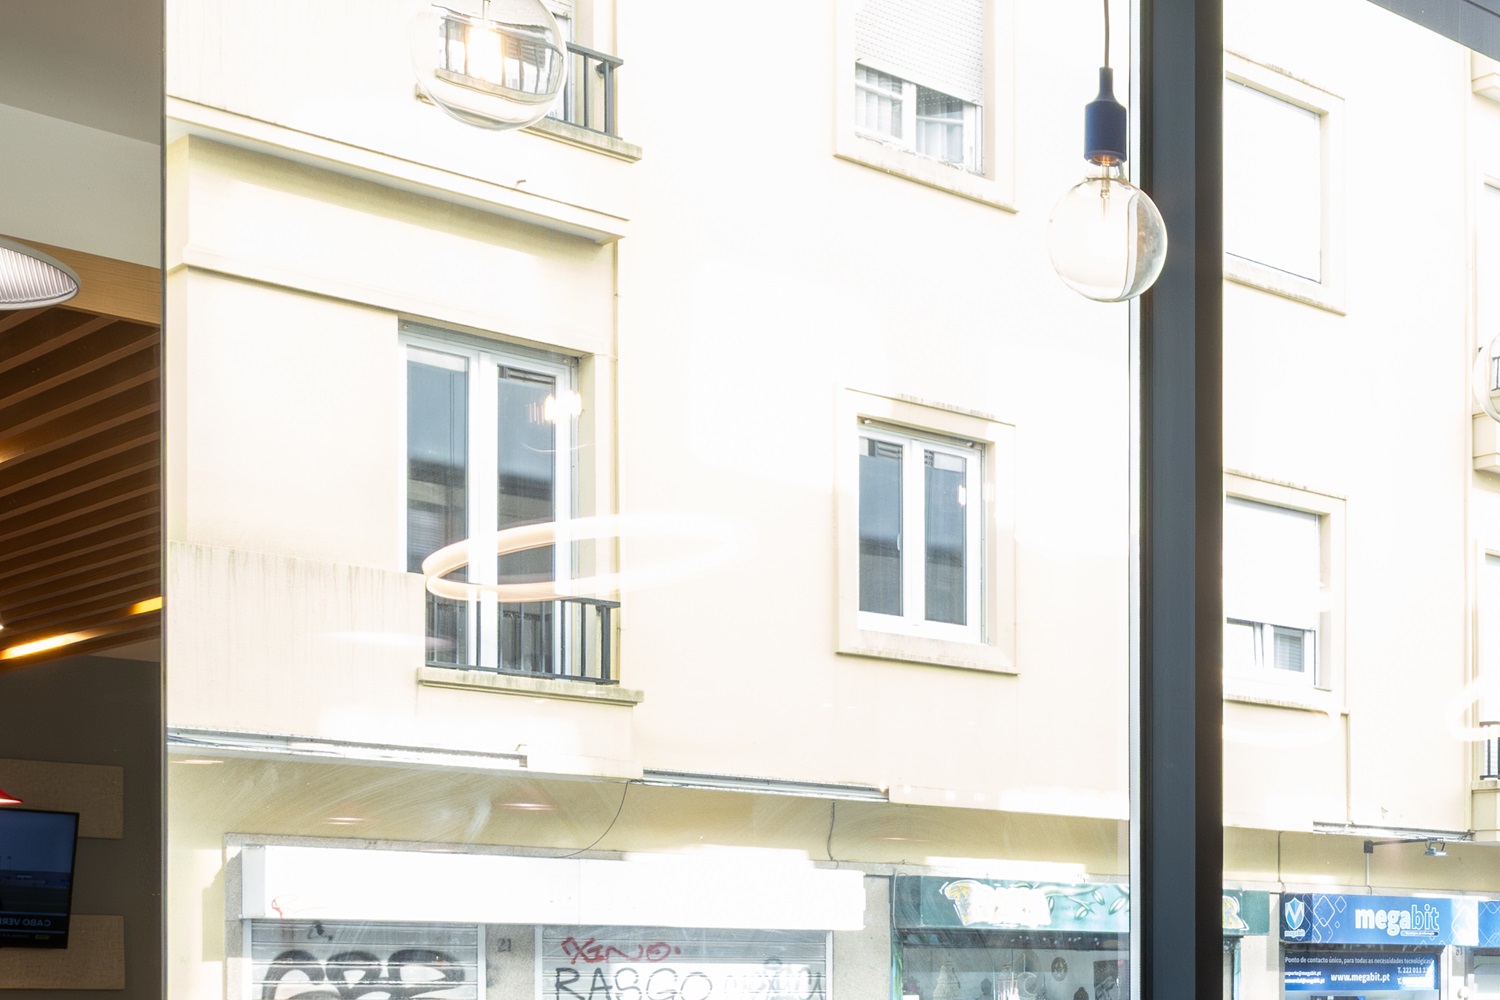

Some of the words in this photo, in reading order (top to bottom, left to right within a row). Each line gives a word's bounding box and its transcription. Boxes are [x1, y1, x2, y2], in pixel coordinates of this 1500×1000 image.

[1355, 903, 1440, 936] megabit
[1329, 957, 1343, 965] único,
[1344, 958, 1354, 966] para
[1331, 972, 1390, 984] www.megabit.pt
